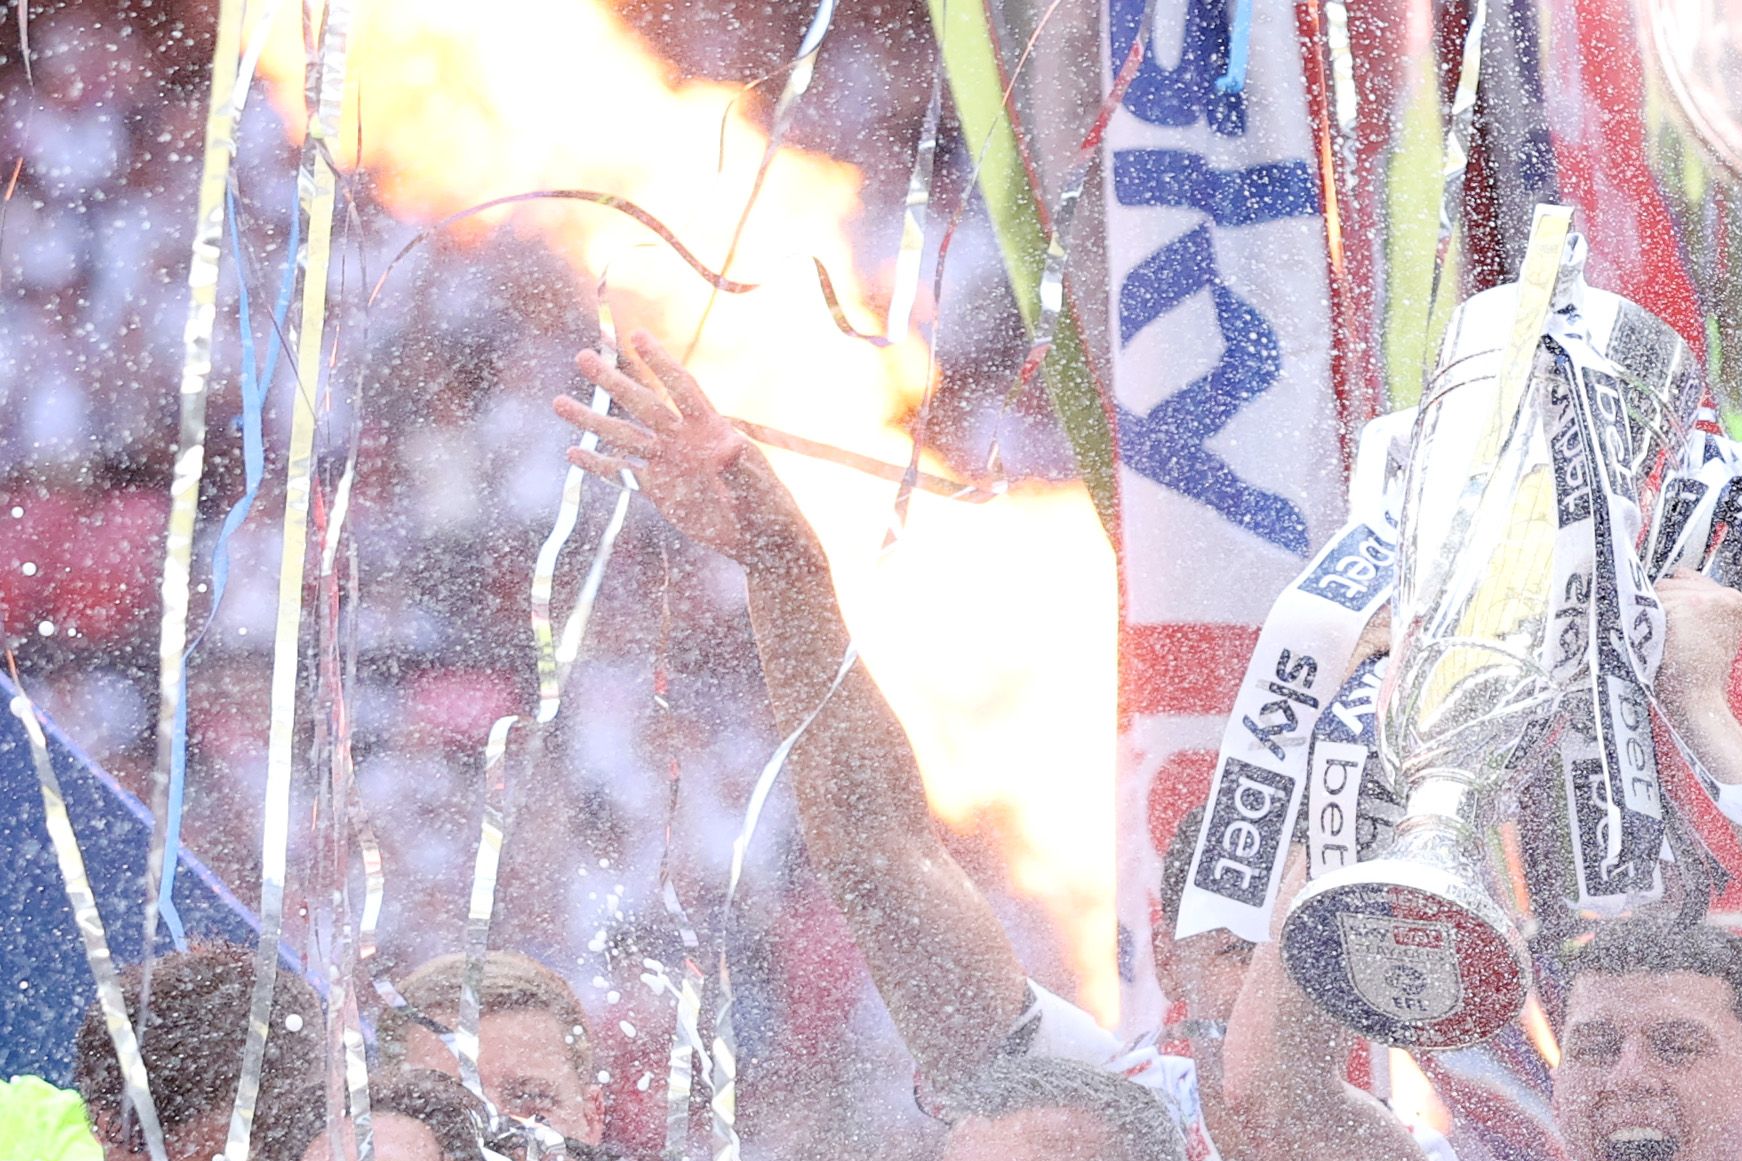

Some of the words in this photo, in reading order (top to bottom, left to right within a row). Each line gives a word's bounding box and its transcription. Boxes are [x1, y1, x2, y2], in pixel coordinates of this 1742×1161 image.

[1242, 649, 1319, 761] sky
[1211, 776, 1286, 891] bet
[1322, 758, 1361, 867] bet
